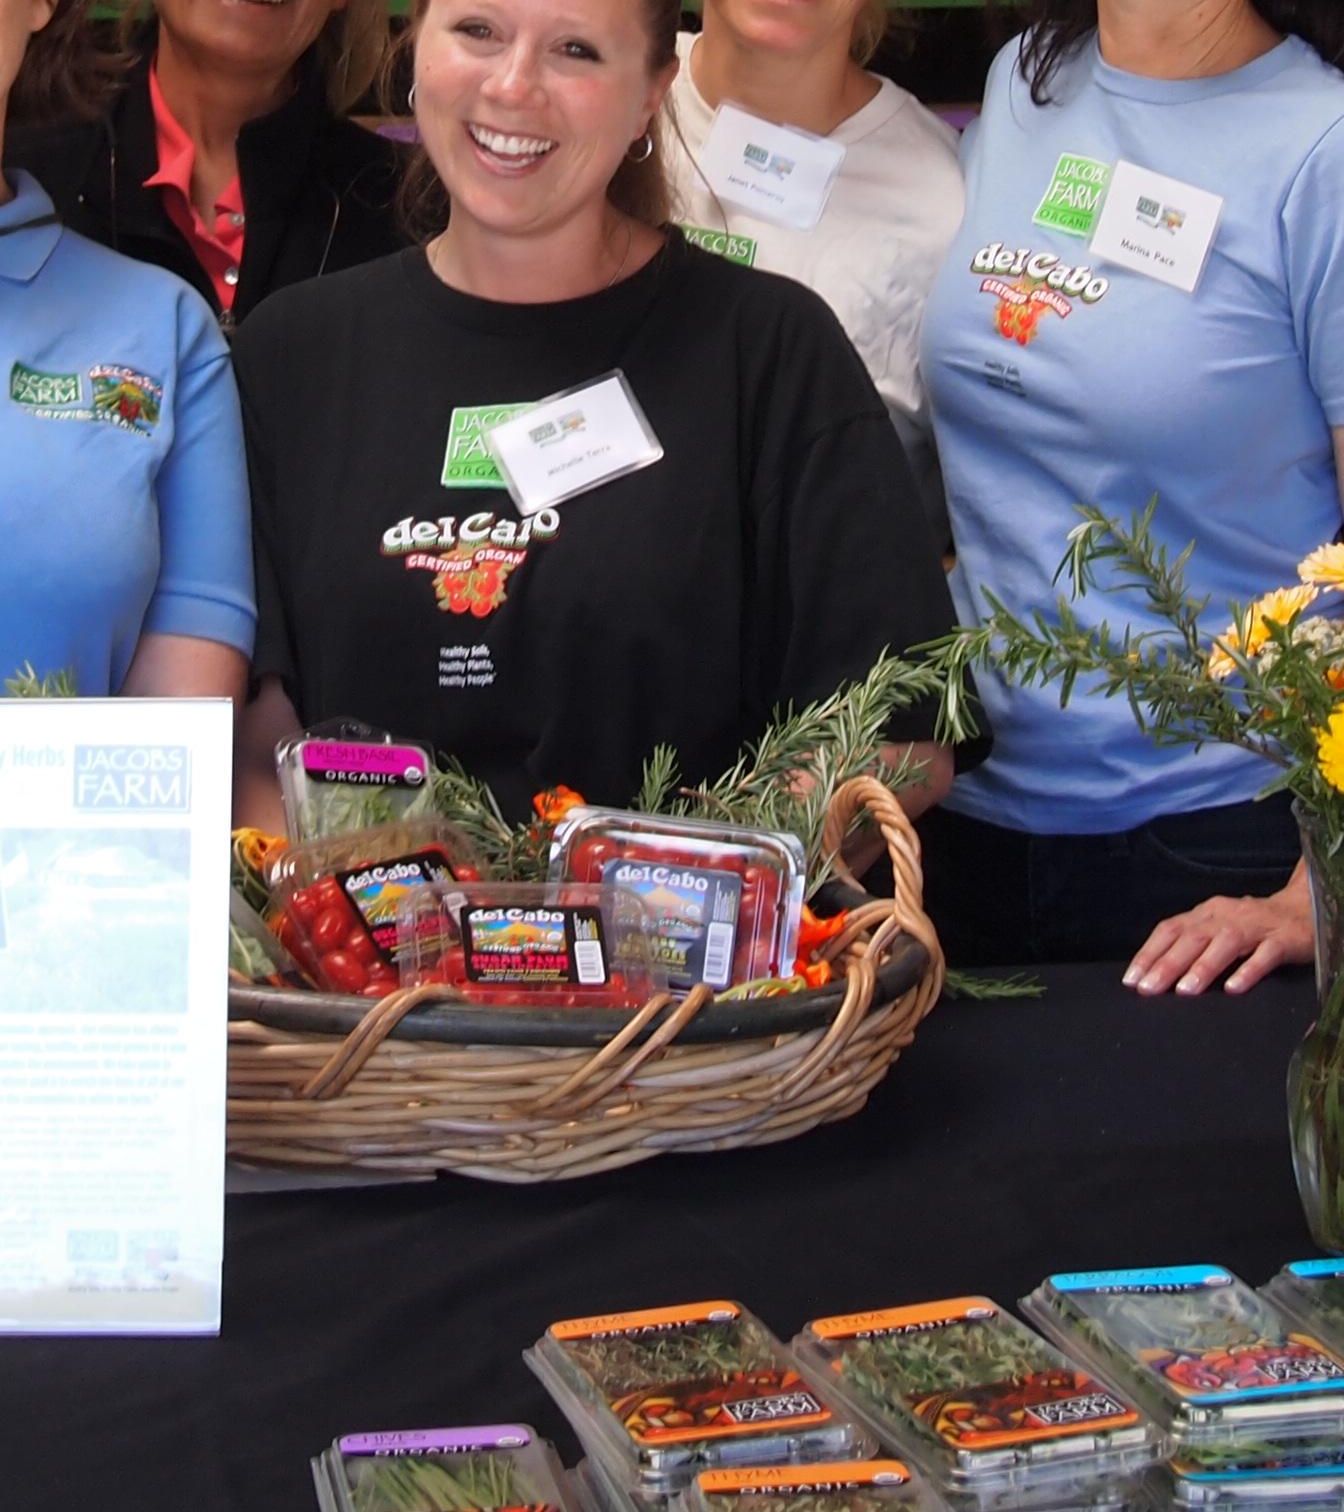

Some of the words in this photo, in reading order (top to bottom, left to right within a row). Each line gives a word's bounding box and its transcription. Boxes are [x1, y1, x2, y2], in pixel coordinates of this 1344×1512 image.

[1059, 161, 1105, 184] JACOB
[1050, 181, 1101, 211] FARM
[1121, 239, 1150, 259] Marina
[974, 243, 1109, 299] delCabo
[449, 464, 500, 477] ORGA
[408, 555, 472, 570] CERTIFIED
[475, 550, 524, 564] ORGAN
[13, 745, 65, 767] Herbs
[79, 748, 183, 772] JACOBS
[325, 770, 397, 784] ORGANIC
[77, 774, 180, 805] FARM
[345, 863, 420, 893] delCabo
[616, 865, 708, 891] delCabo
[469, 908, 564, 922] delCabo
